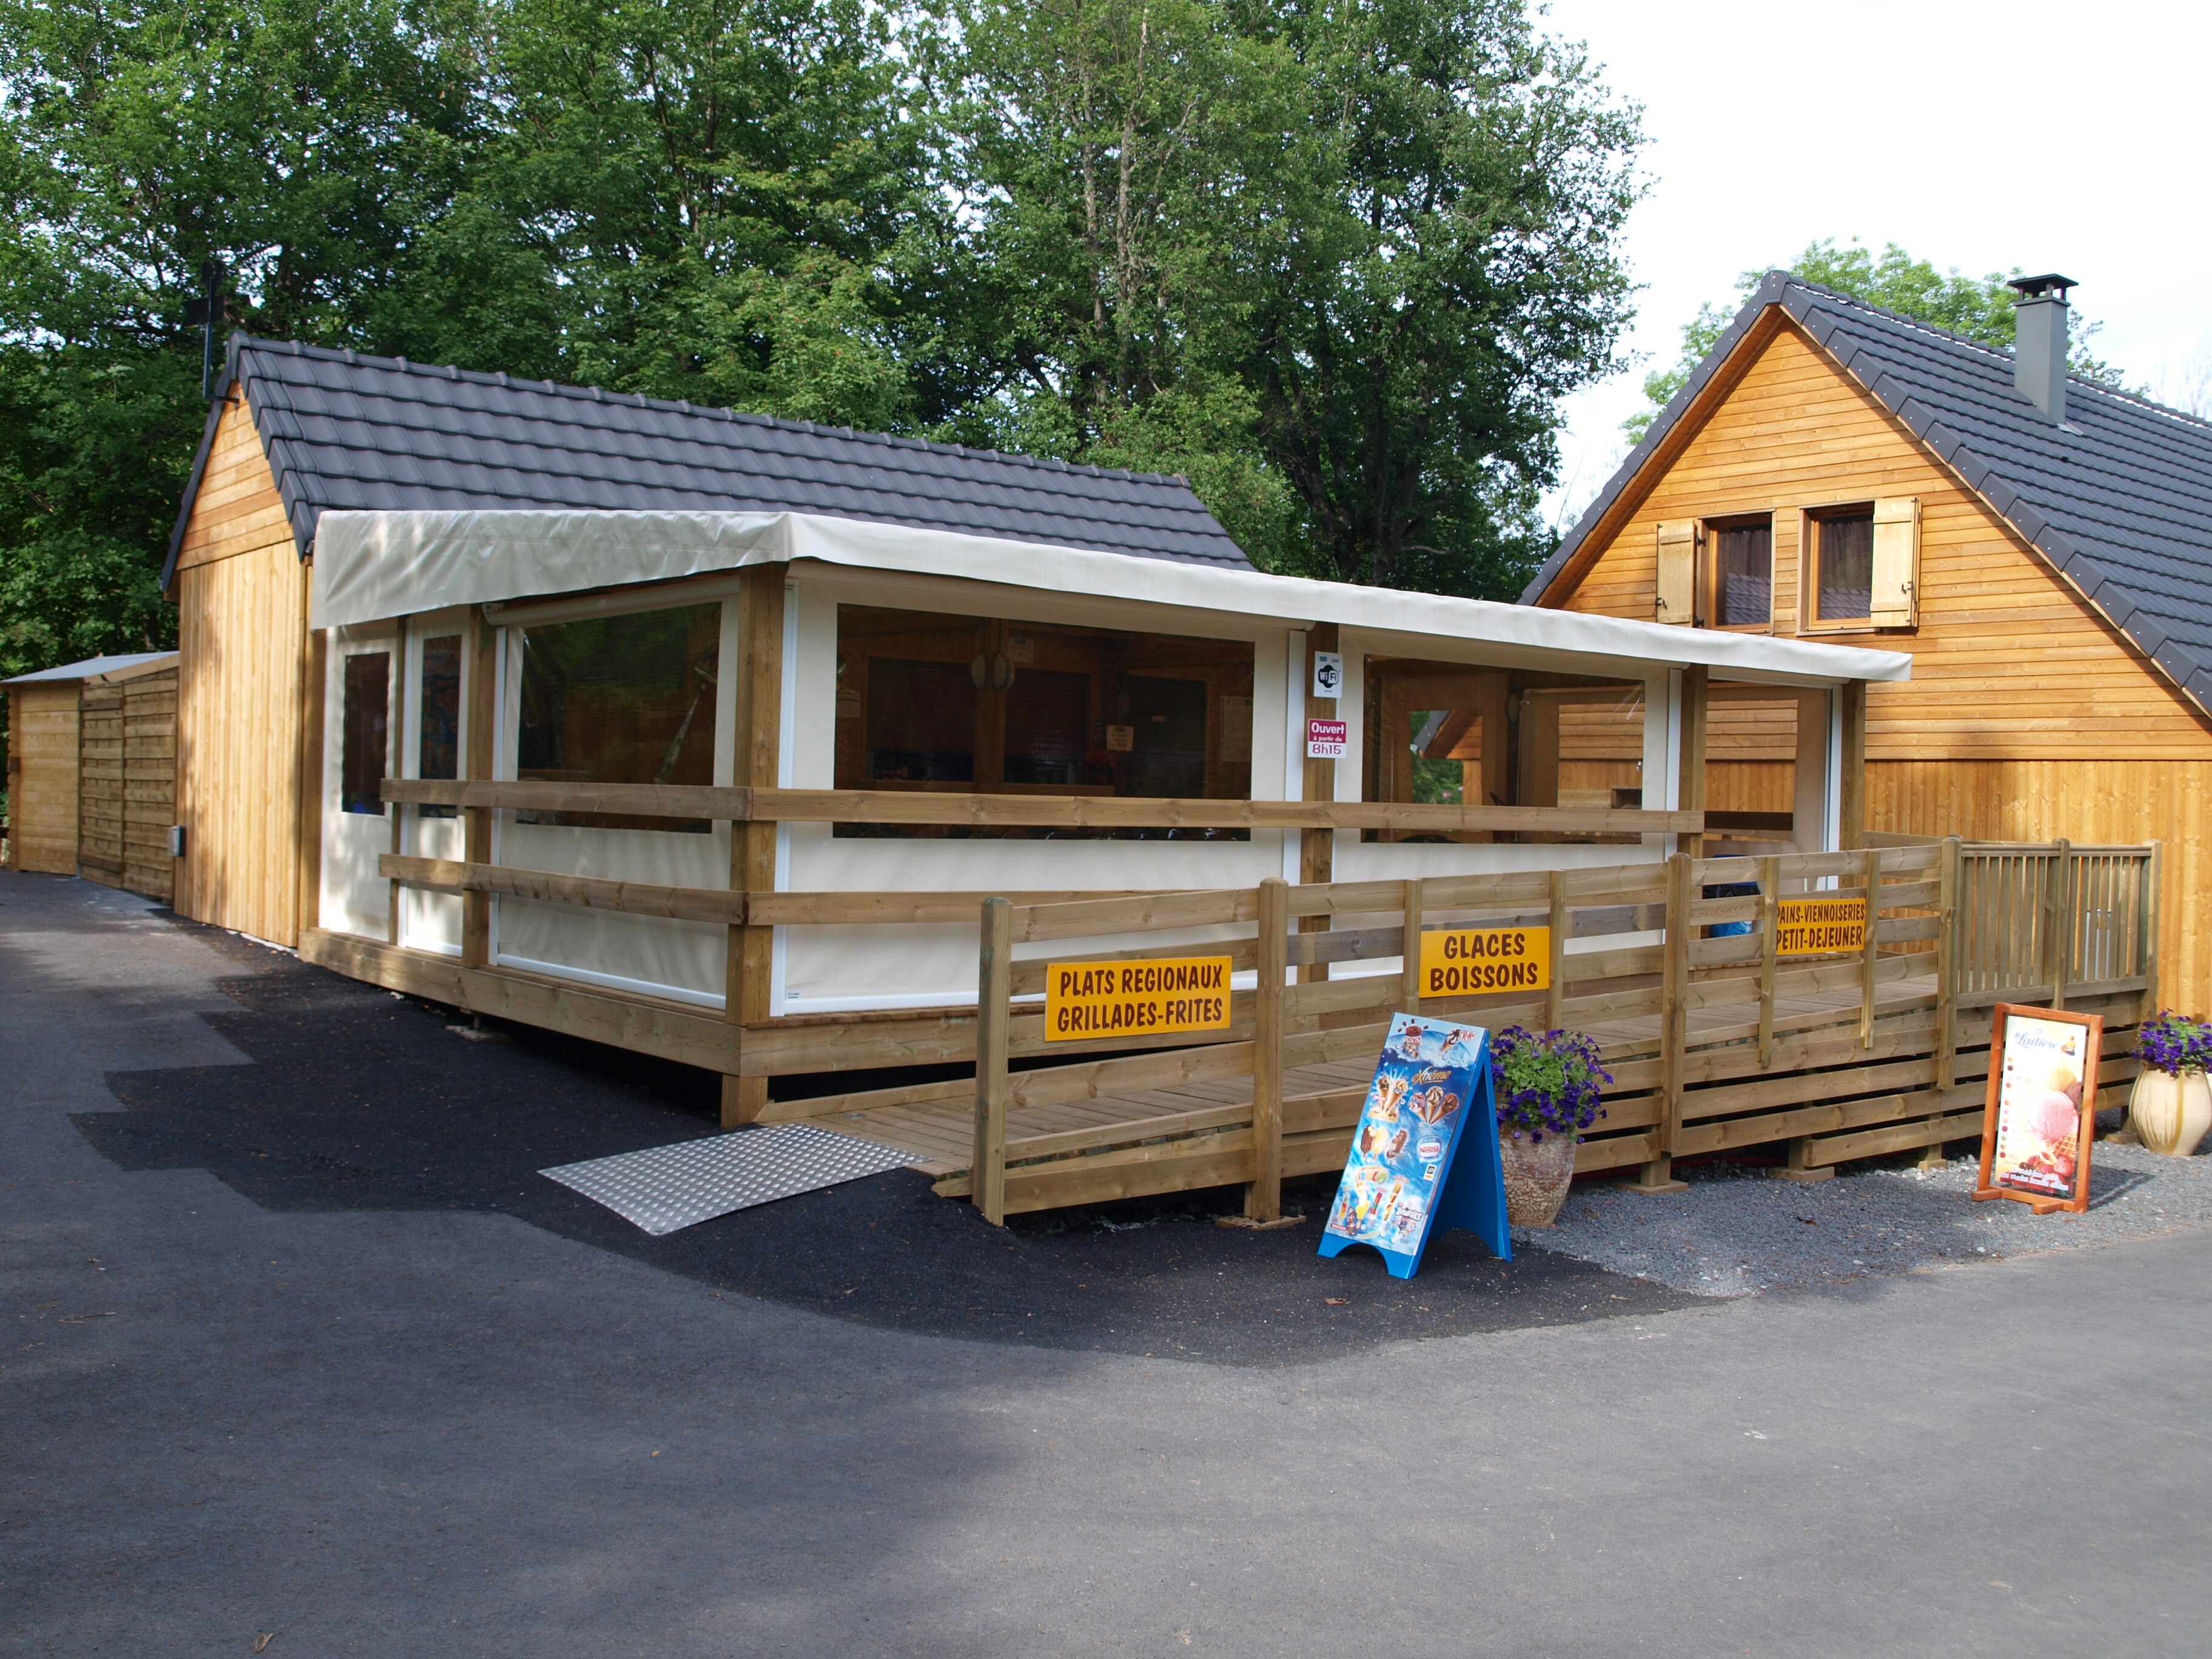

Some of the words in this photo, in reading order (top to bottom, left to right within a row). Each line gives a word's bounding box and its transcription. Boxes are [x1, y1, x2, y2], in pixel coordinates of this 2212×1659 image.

[1311, 722, 1344, 734] Ouvert
[1312, 743, 1341, 754] 8h15
[1444, 933, 1525, 959] GLACES
[1776, 925, 1862, 951] PETIT-DEJEUNER
[1060, 969, 1114, 997] PLATS
[1121, 964, 1222, 994] REGIONAUX
[1430, 962, 1538, 991] BOISSONS
[1057, 997, 1222, 1032] GRILLADES-FRITES
